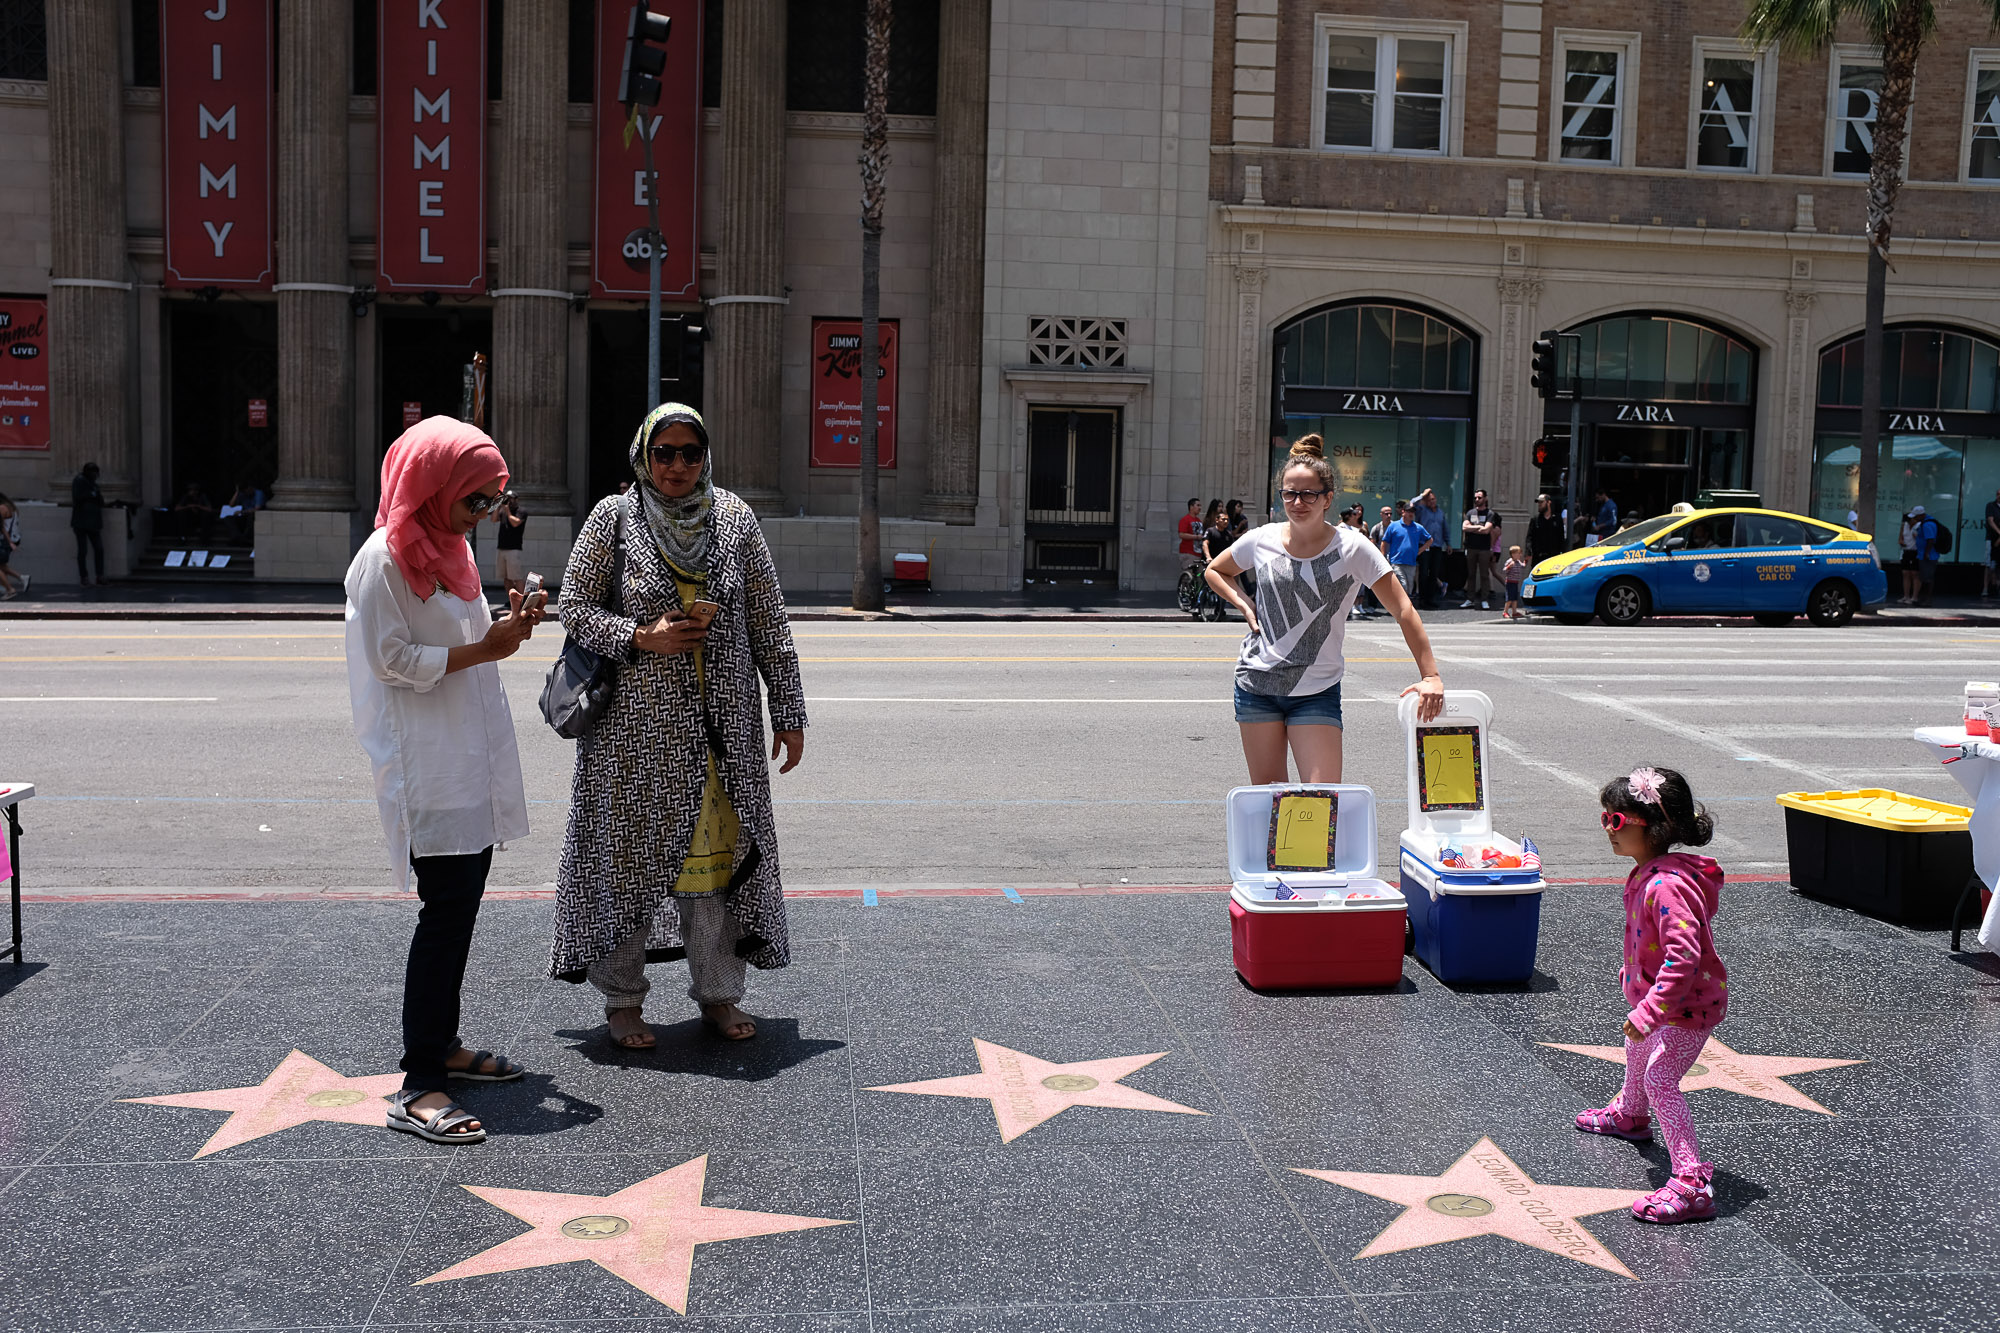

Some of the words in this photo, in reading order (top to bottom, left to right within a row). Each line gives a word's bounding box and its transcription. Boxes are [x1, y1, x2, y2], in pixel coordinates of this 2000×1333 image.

[200, 0, 237, 257] JIMMY
[413, 0, 450, 264] KIMMEL
[830, 337, 860, 348] JIMMY
[12, 347, 37, 355] LIVE!
[1342, 394, 1404, 411] ZARA
[1617, 405, 1674, 422] ZARA
[1888, 414, 1945, 431] ZARA
[1333, 445, 1372, 458] SALE
[1623, 550, 1647, 559] 3747
[1756, 565, 1796, 574] CHECKER
[1758, 573, 1777, 581] CAB
[1778, 572, 1794, 581] CO.
[1470, 1152, 1531, 1197] LEONARD
[1518, 1199, 1596, 1259] GOLDBERG
